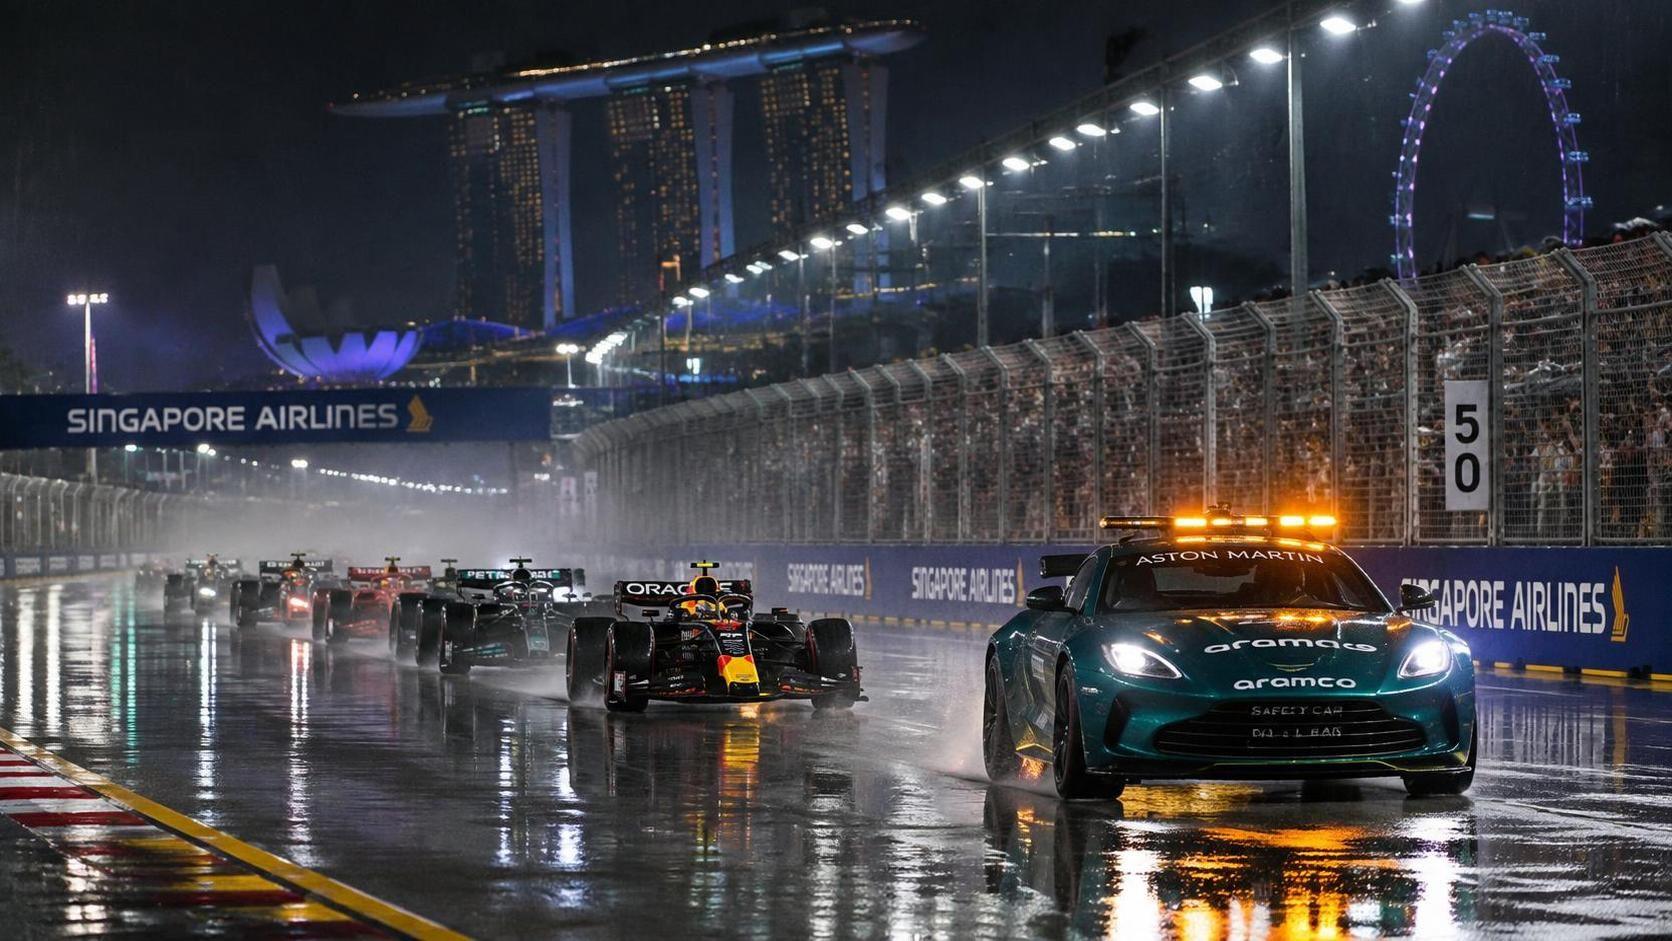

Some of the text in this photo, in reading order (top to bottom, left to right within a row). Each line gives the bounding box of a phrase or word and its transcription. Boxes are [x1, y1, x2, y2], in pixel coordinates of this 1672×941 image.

[67, 403, 398, 434] SINGAPORE AIRLINES
[1136, 550, 1324, 566] ASTON MARTIN
[626, 582, 733, 595] ORACE
[911, 566, 1015, 604] SINGAPORE AIRLINES
[1510, 581, 1606, 634] AIRLINES
[1233, 677, 1357, 690] aramco
